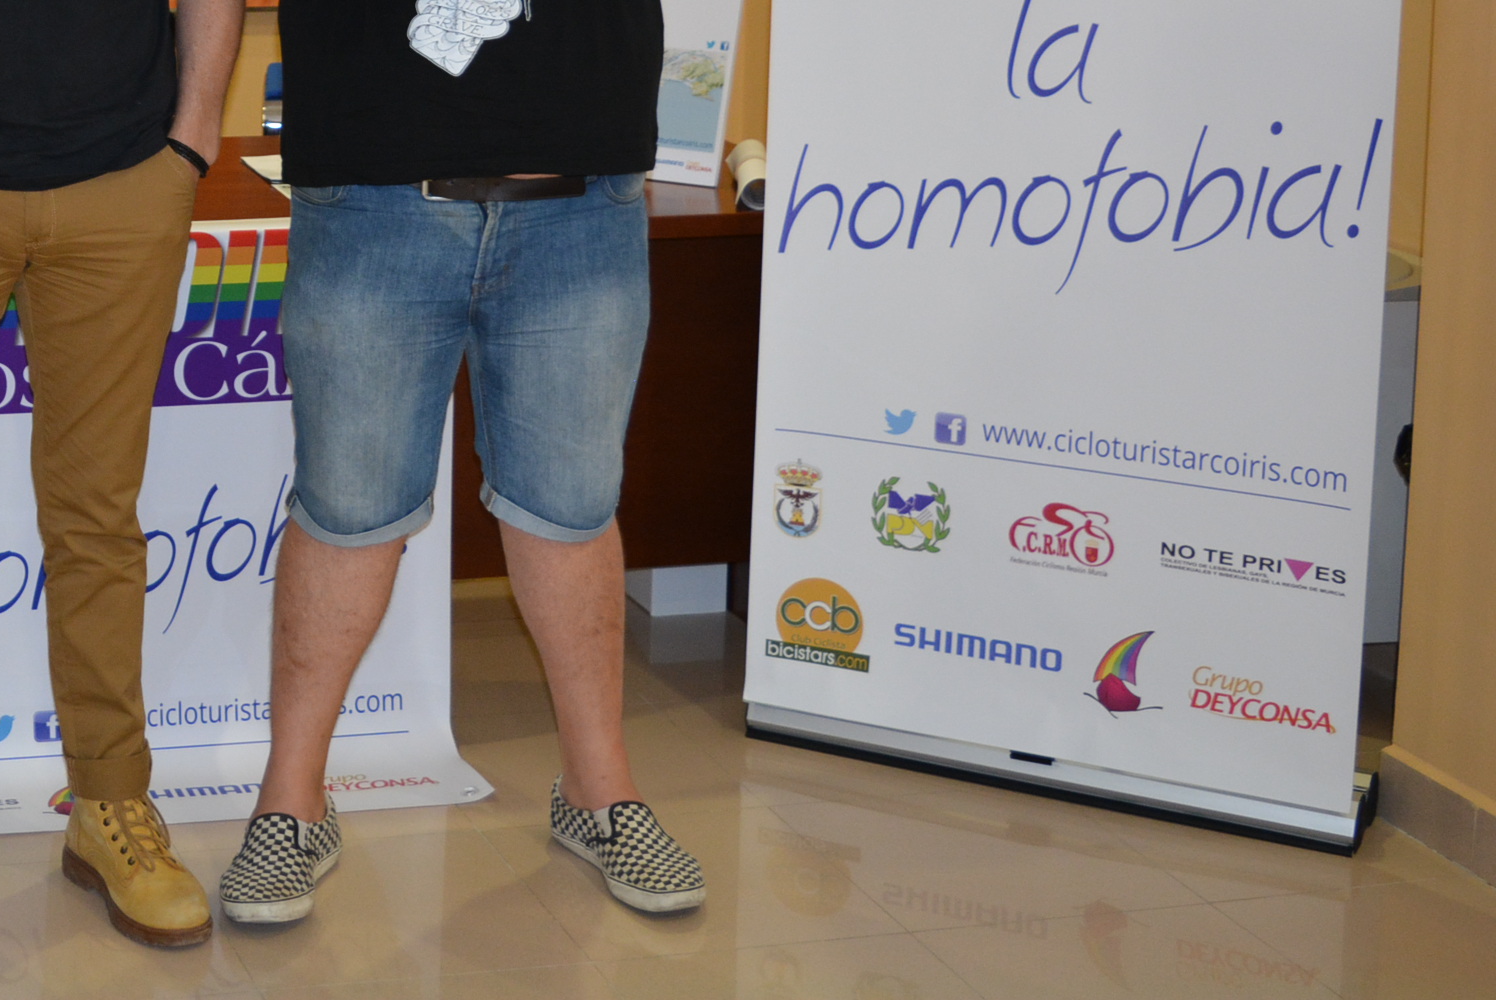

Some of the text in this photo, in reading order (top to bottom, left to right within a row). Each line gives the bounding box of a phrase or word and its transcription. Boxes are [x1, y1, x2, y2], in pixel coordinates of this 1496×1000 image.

[778, 118, 1384, 294] homofobia!
[983, 423, 1347, 492] www.cicloturistarcoiris.com
[1160, 542, 1195, 559] NO
[1203, 548, 1234, 566] TE
[1160, 557, 1197, 568] COLECTIVO
[1319, 588, 1346, 597] MURCIA
[780, 595, 859, 635] ccb
[767, 641, 868, 671] bicistars.com
[894, 623, 1062, 672] SHIMANO
[1192, 665, 1263, 696] Grupo
[1190, 689, 1332, 734] DEYCONSA
